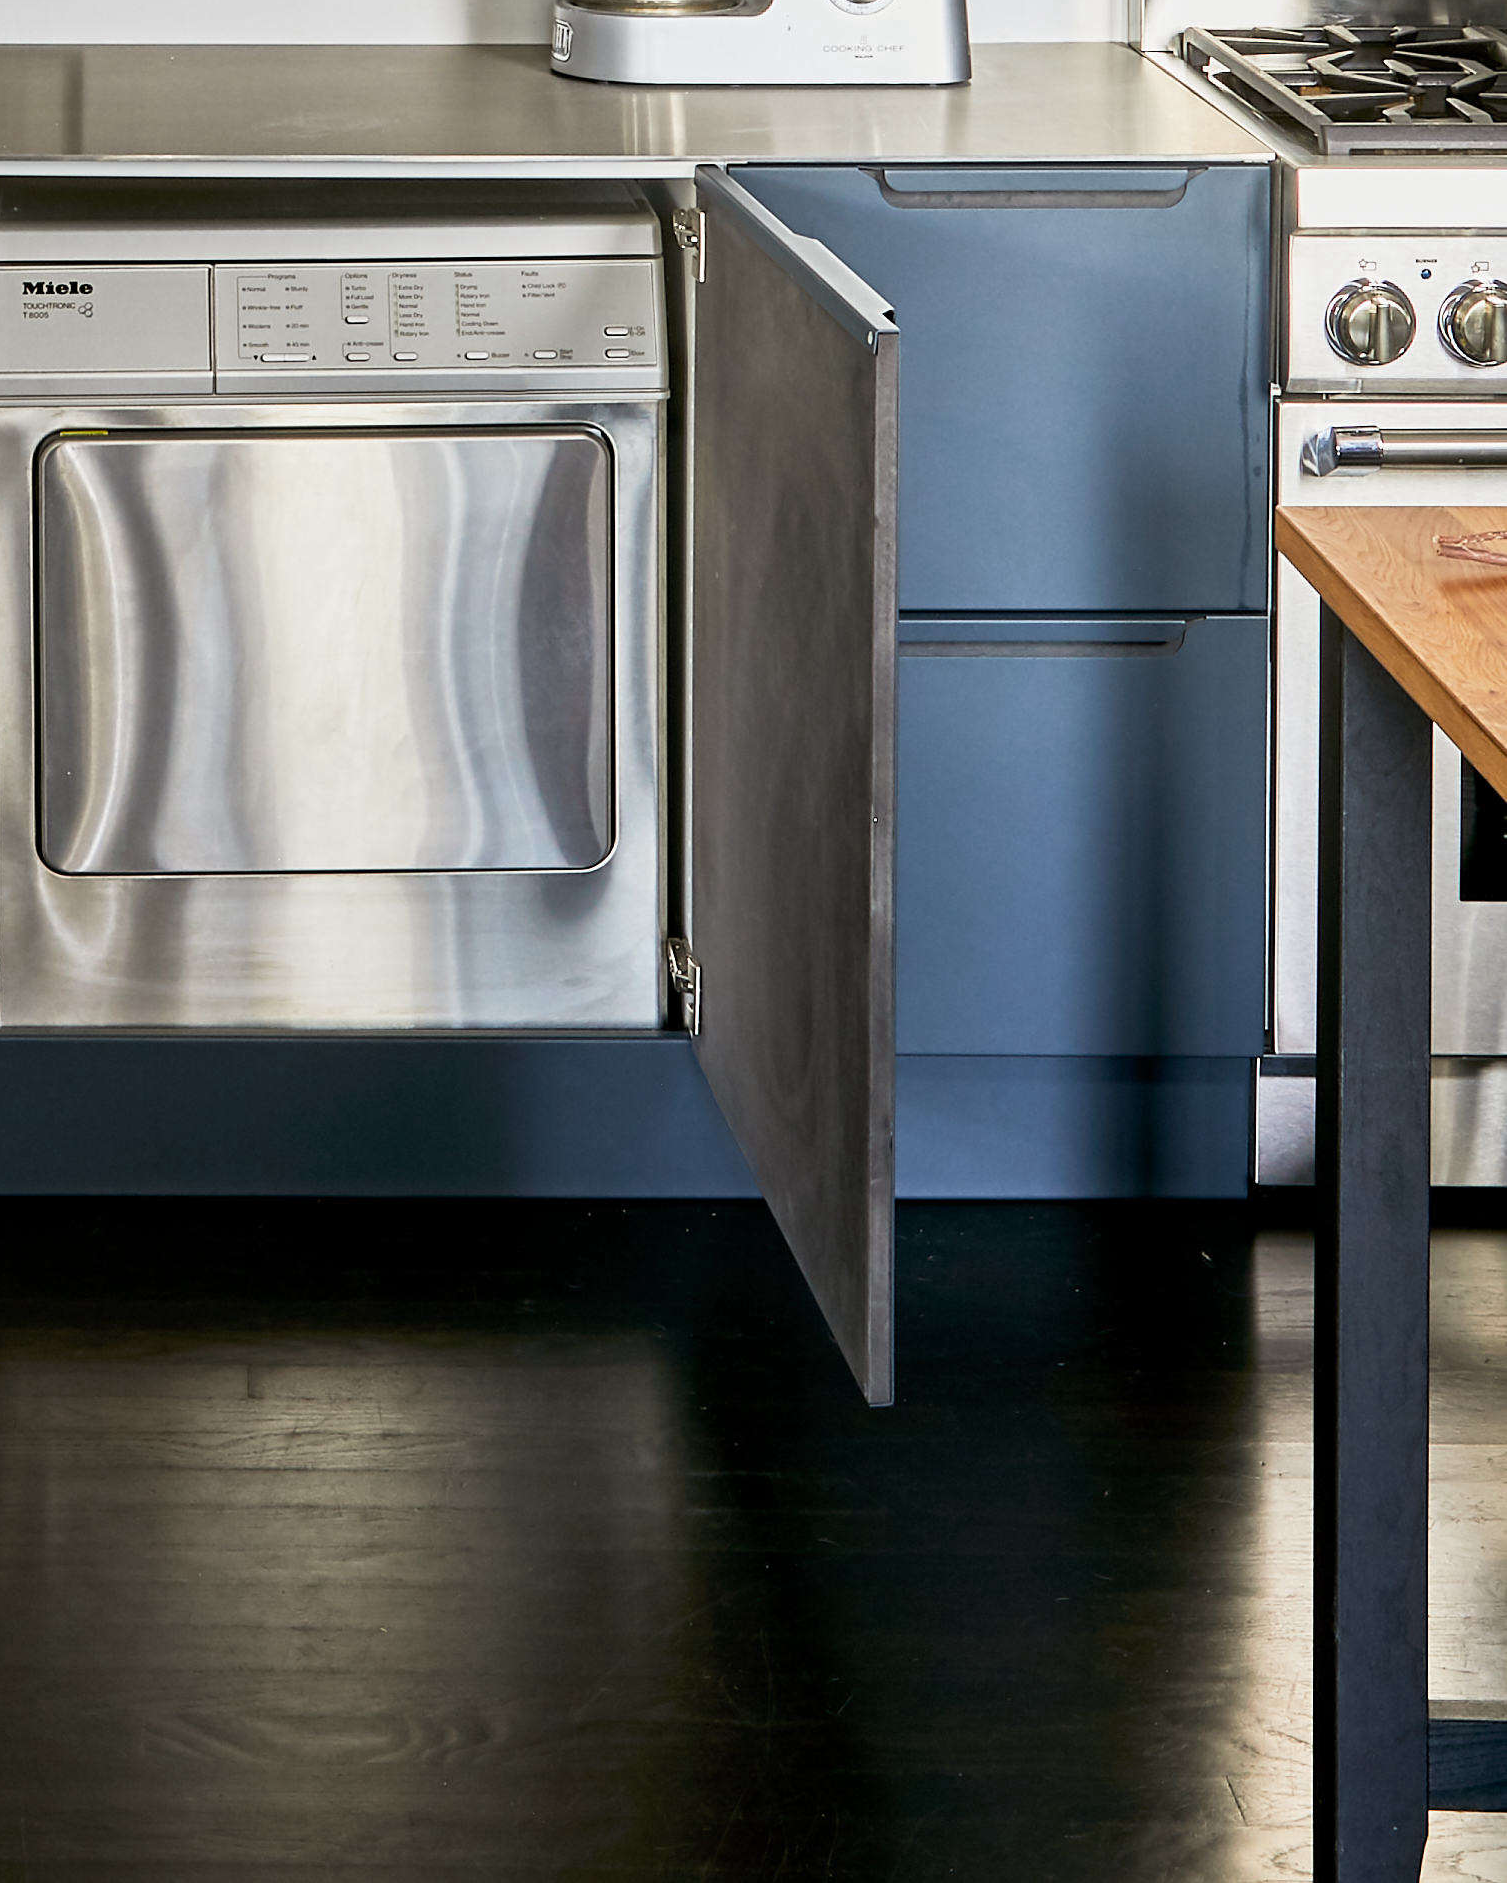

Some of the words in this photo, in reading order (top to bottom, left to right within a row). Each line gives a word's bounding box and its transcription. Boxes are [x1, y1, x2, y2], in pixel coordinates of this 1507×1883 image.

[822, 45, 873, 53] COOKING
[22, 281, 94, 295] Miele
[23, 302, 76, 310] TOUCHTRONIC
[23, 311, 27, 319] T
